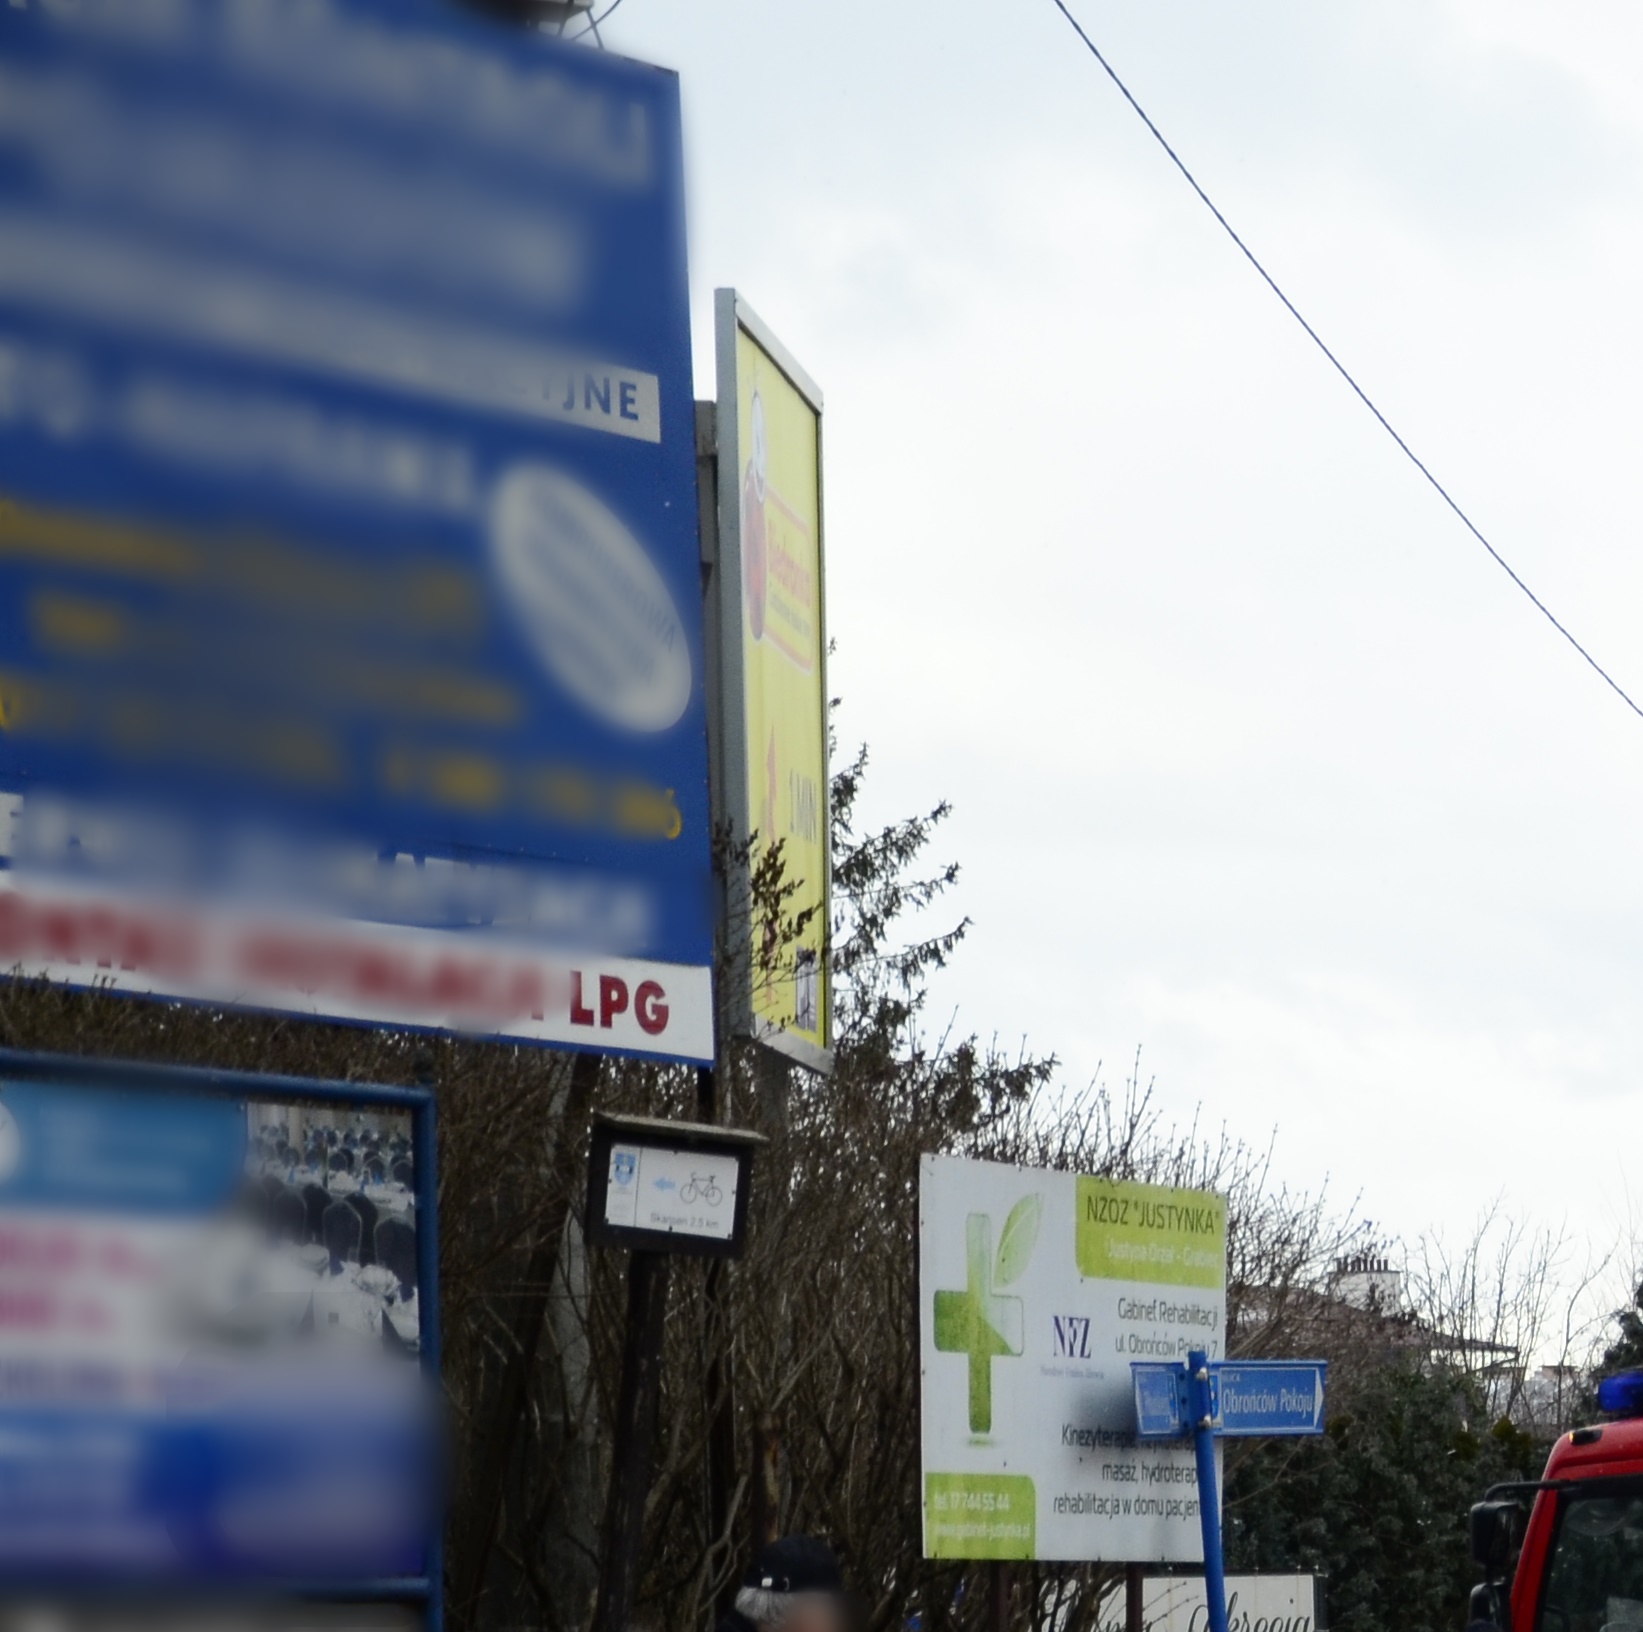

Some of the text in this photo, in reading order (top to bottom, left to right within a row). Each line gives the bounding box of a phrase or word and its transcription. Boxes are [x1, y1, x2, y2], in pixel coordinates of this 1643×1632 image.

[570, 970, 669, 1036] LPG
[1086, 1194, 1129, 1225] NZOZ
[1117, 1297, 1219, 1331] Gabinet Rehabilitacji
[1052, 1315, 1092, 1359] NFZ
[1115, 1337, 1125, 1353] ul.
[1128, 1332, 1176, 1355] Obrońców
[1211, 1340, 1218, 1359] 7
[1222, 1387, 1313, 1418] Obrońców Pokoju
[1101, 1459, 1198, 1487] masaż, hydroterap
[1053, 1492, 1199, 1521] rehabilitacja w domu pacjen
